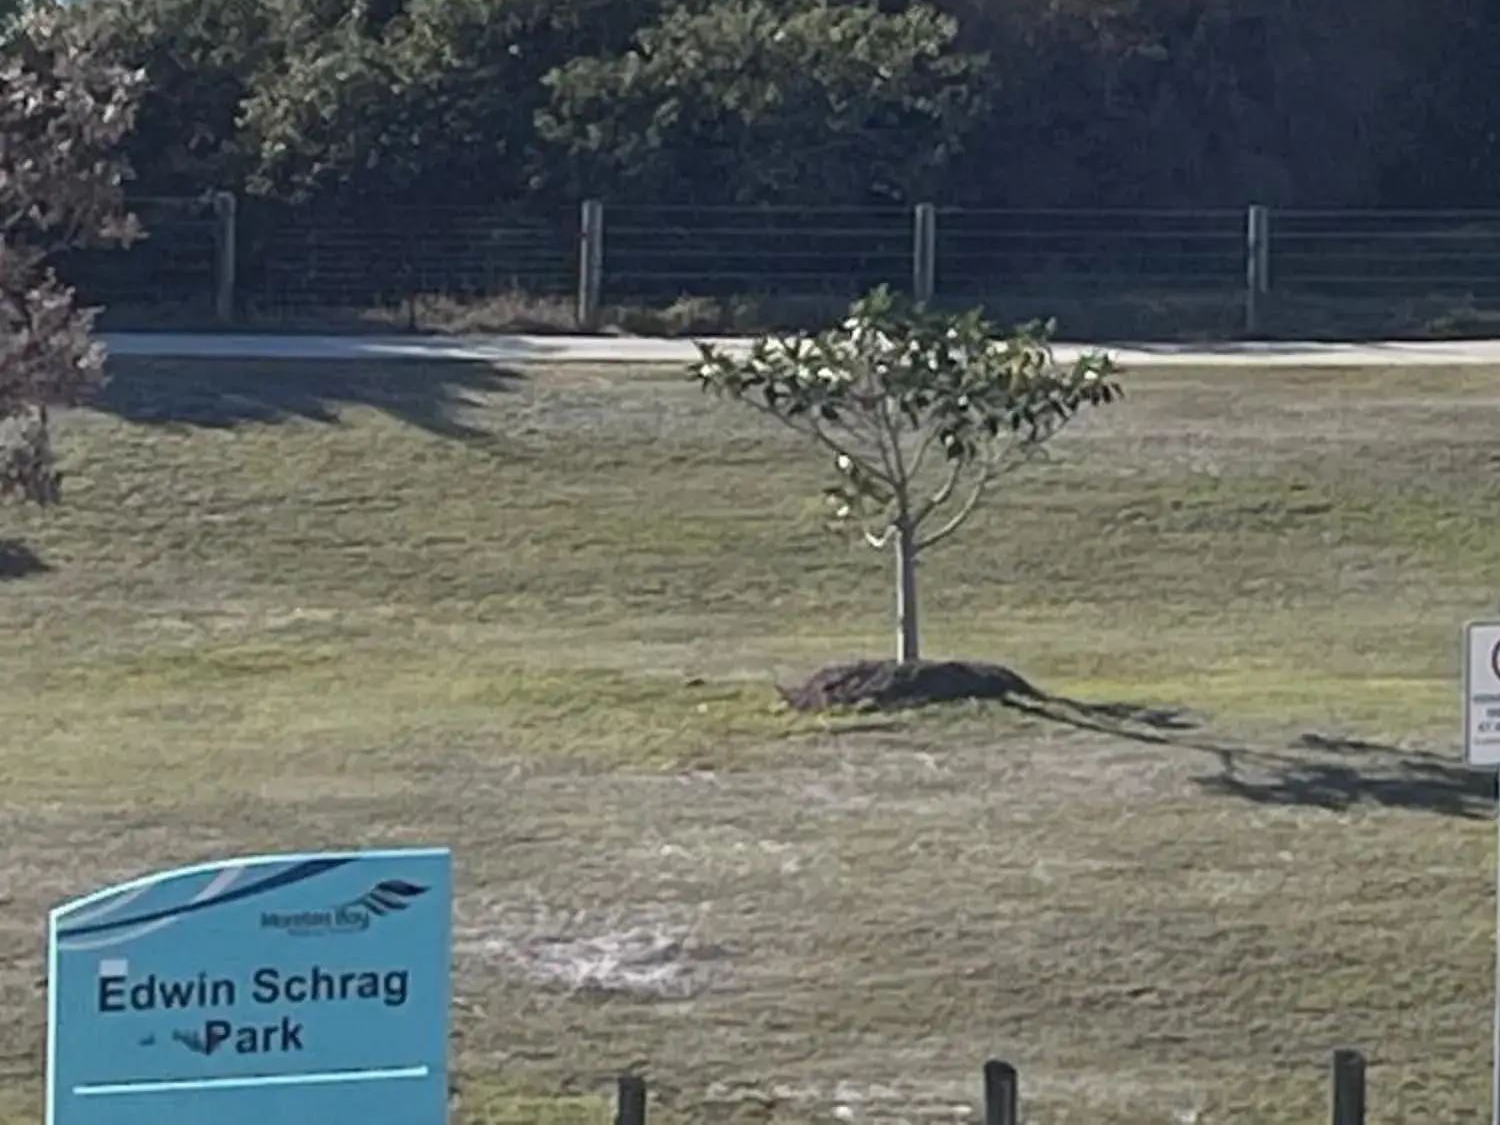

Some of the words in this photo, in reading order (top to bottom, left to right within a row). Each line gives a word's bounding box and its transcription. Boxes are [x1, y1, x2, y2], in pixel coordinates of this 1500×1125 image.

[99, 970, 236, 1013] Edwin
[252, 965, 409, 1007] Schrag
[205, 1017, 304, 1055] Park
